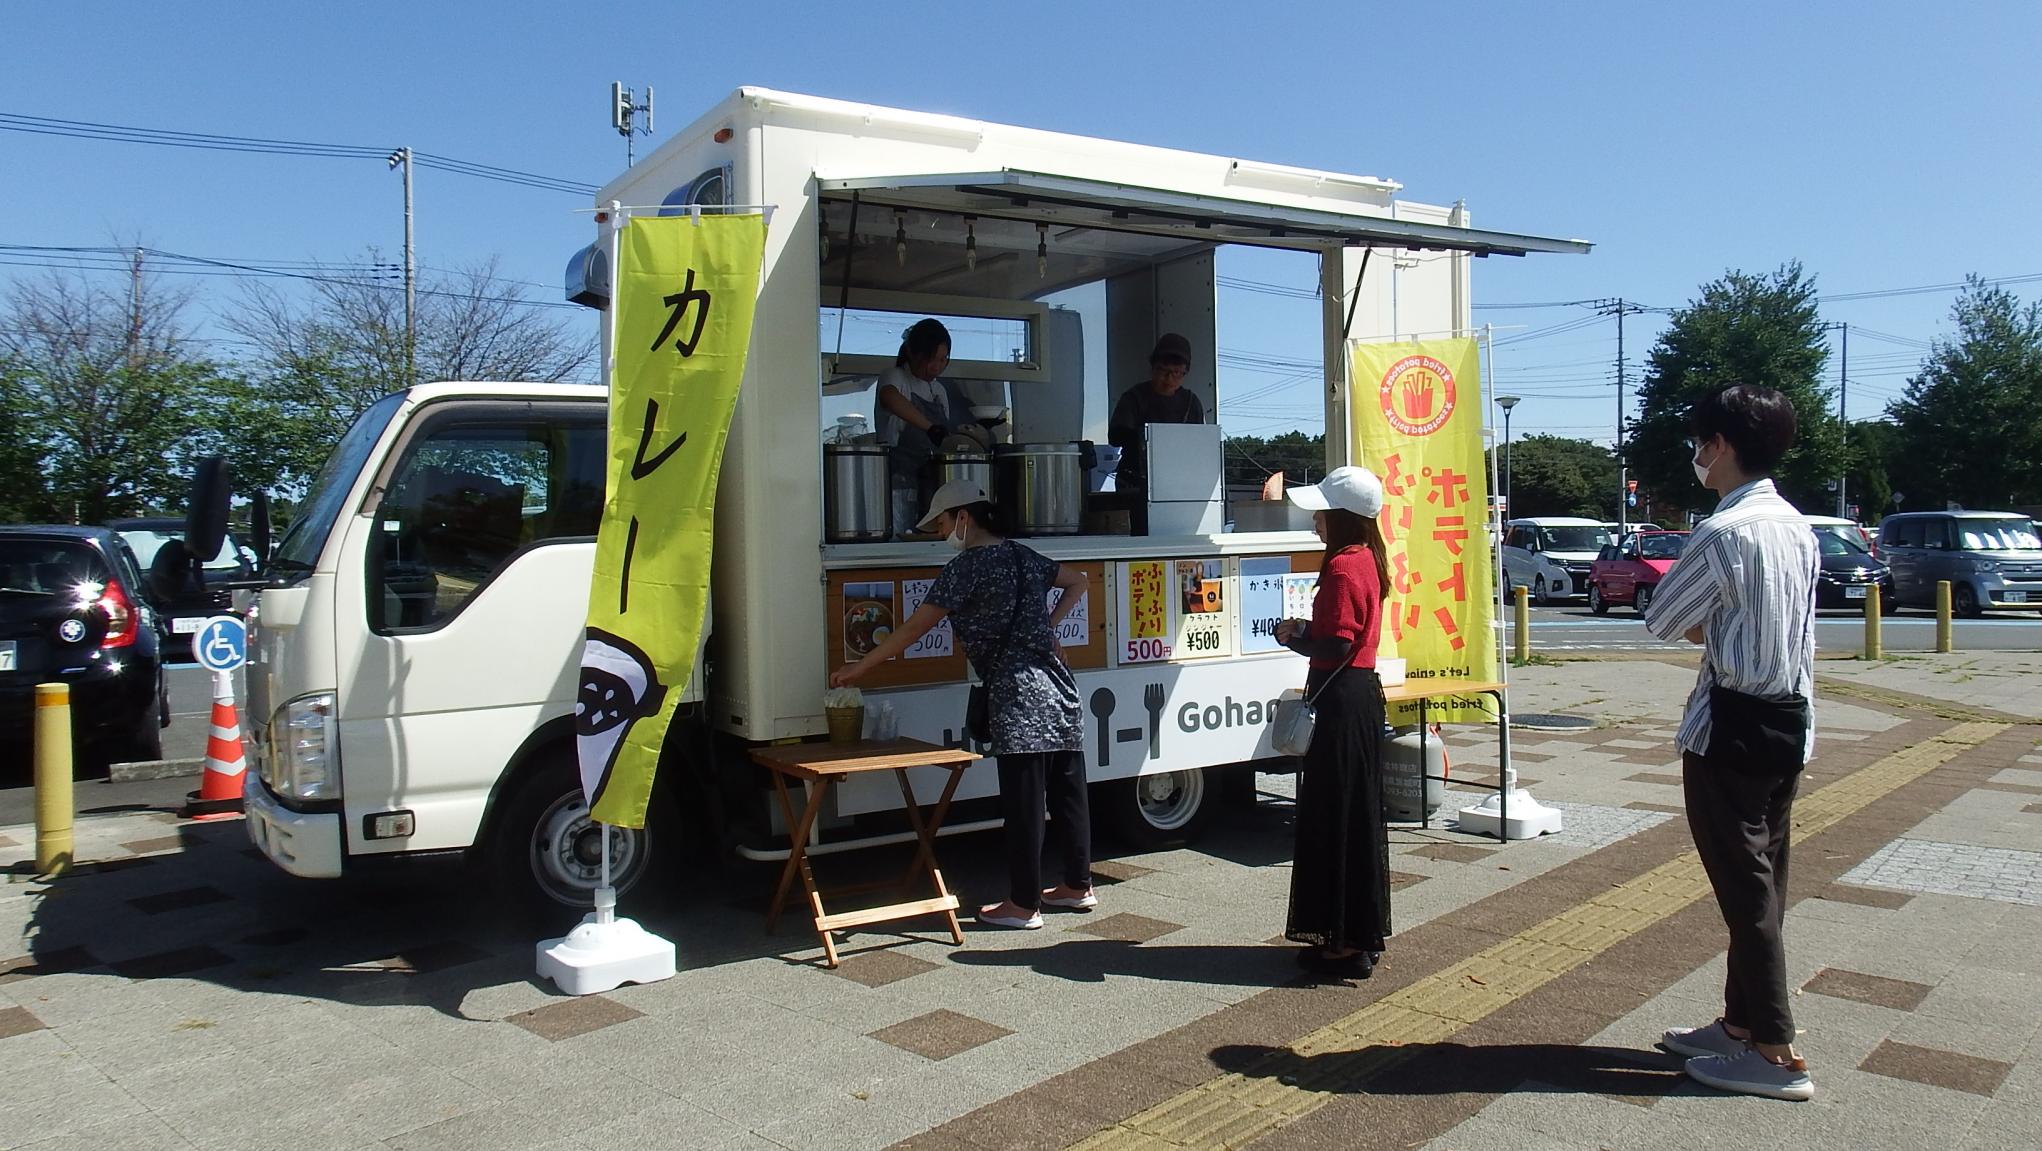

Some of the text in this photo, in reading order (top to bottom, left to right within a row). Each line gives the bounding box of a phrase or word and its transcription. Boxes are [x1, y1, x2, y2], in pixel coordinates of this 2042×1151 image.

[619, 268, 711, 615] カレー
[1127, 639, 1172, 661] 500円
[1186, 630, 1220, 652] ¥500
